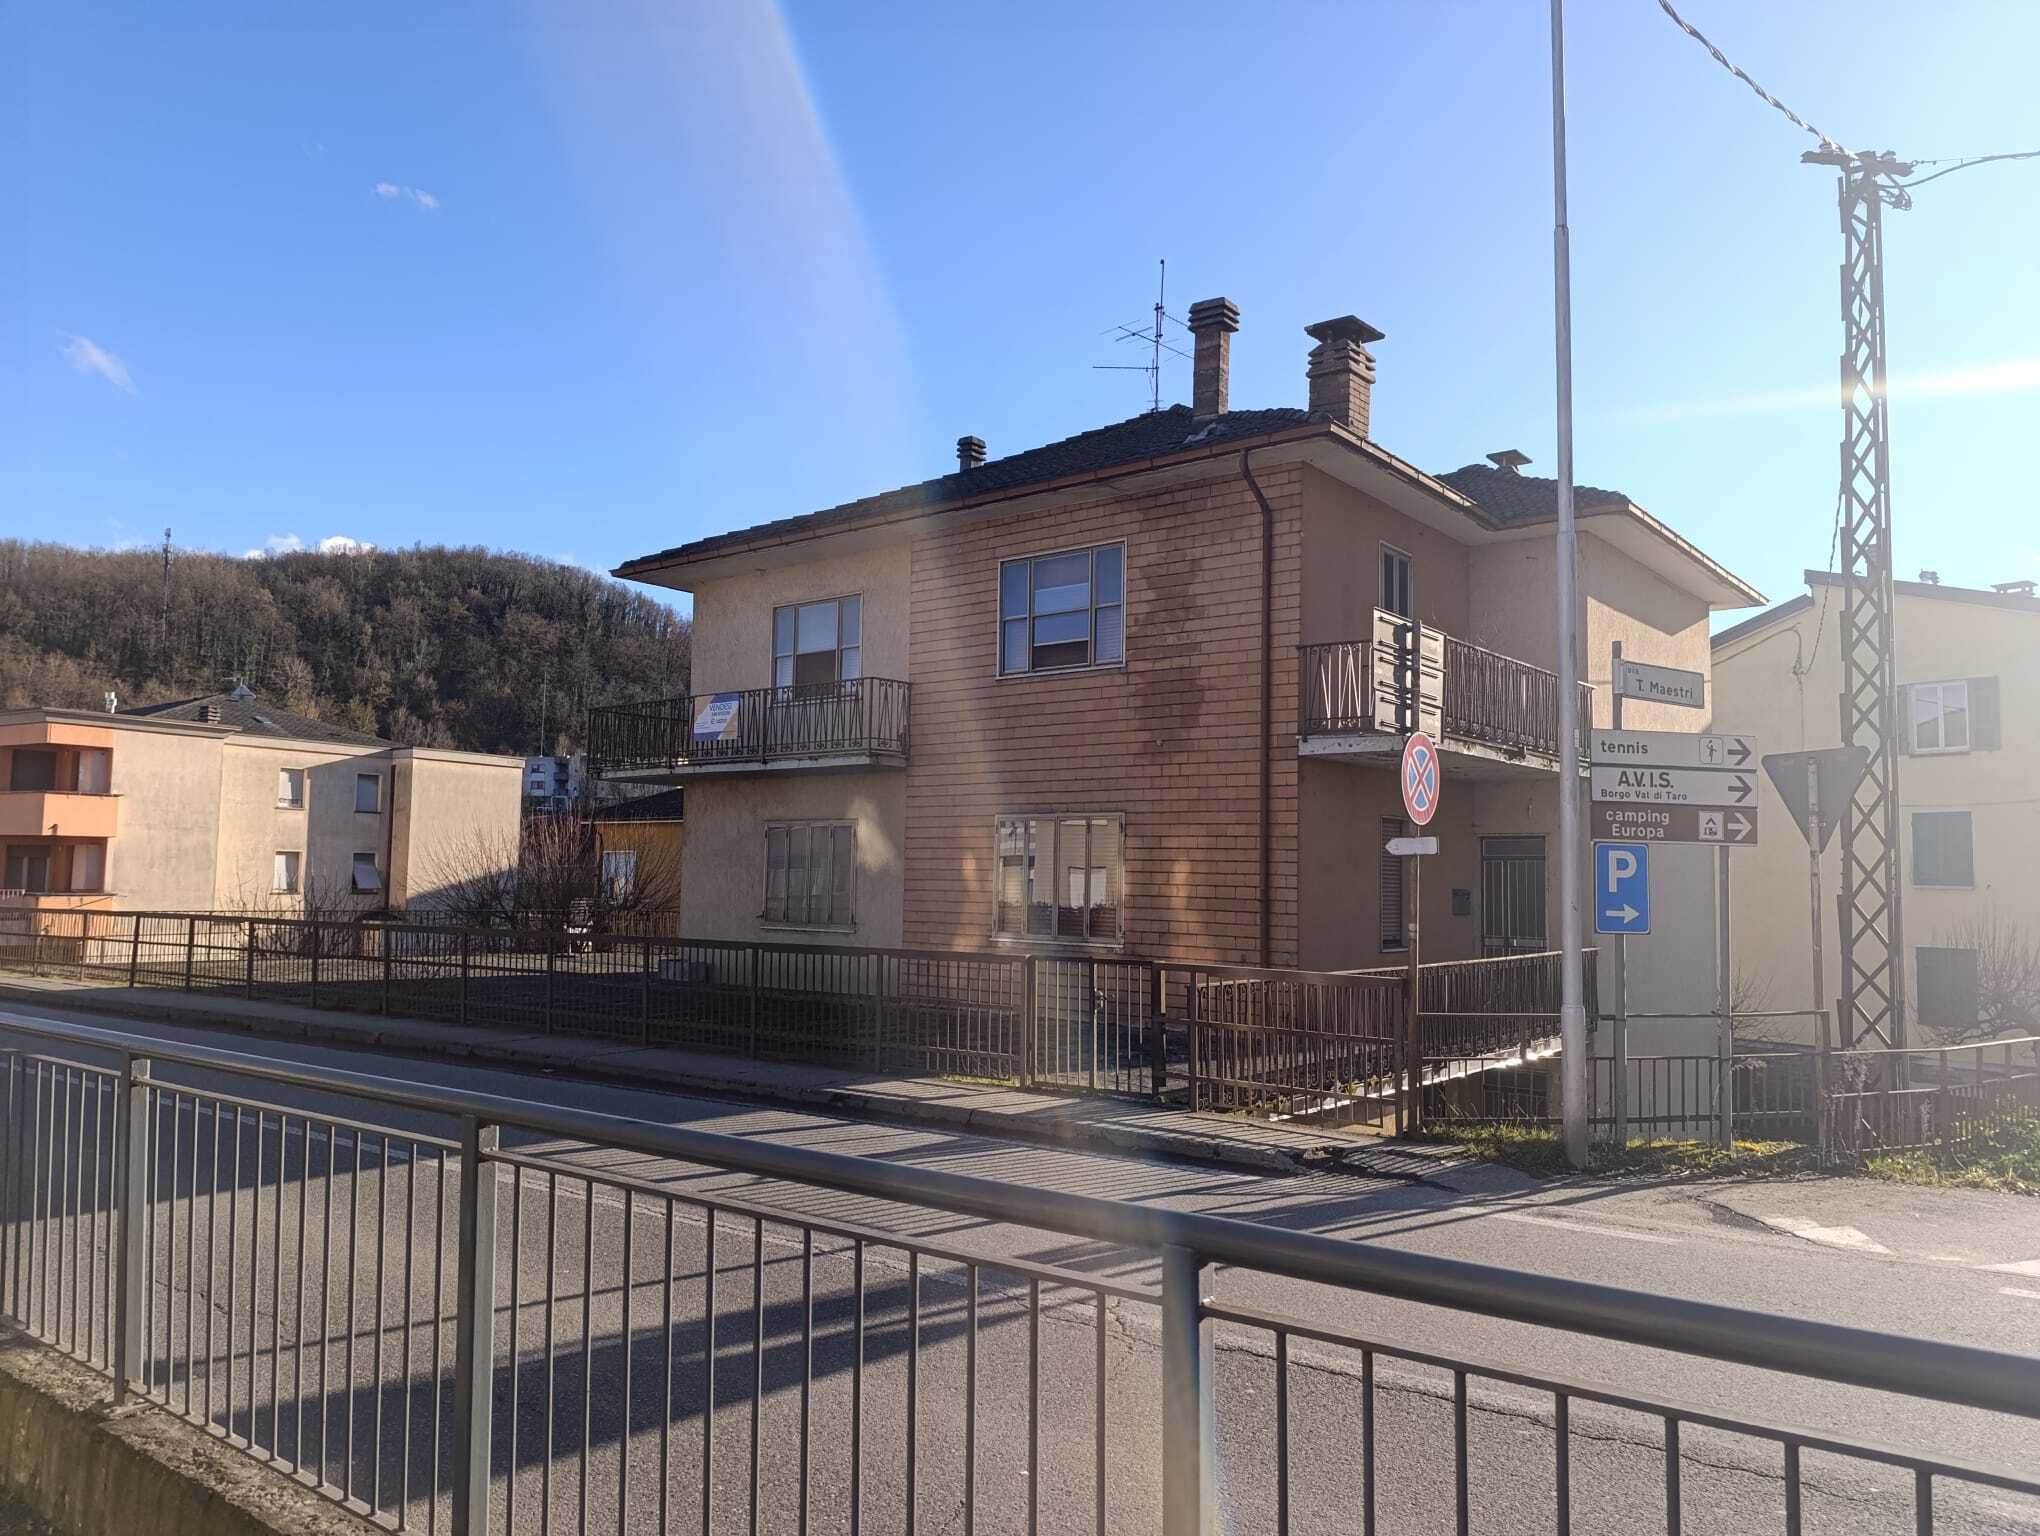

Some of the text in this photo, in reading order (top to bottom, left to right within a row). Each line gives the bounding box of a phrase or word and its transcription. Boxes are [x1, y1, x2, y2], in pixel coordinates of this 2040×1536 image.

[1636, 679, 1693, 699] T. Maestri
[1601, 740, 1649, 754] tennis
[1617, 770, 1674, 789] A.V.I.S.
[1601, 788, 1687, 801] Borgo Val di Taro
[1606, 809, 1670, 825] camping
[1612, 824, 1665, 839] Europa
[1608, 850, 1637, 892] P
